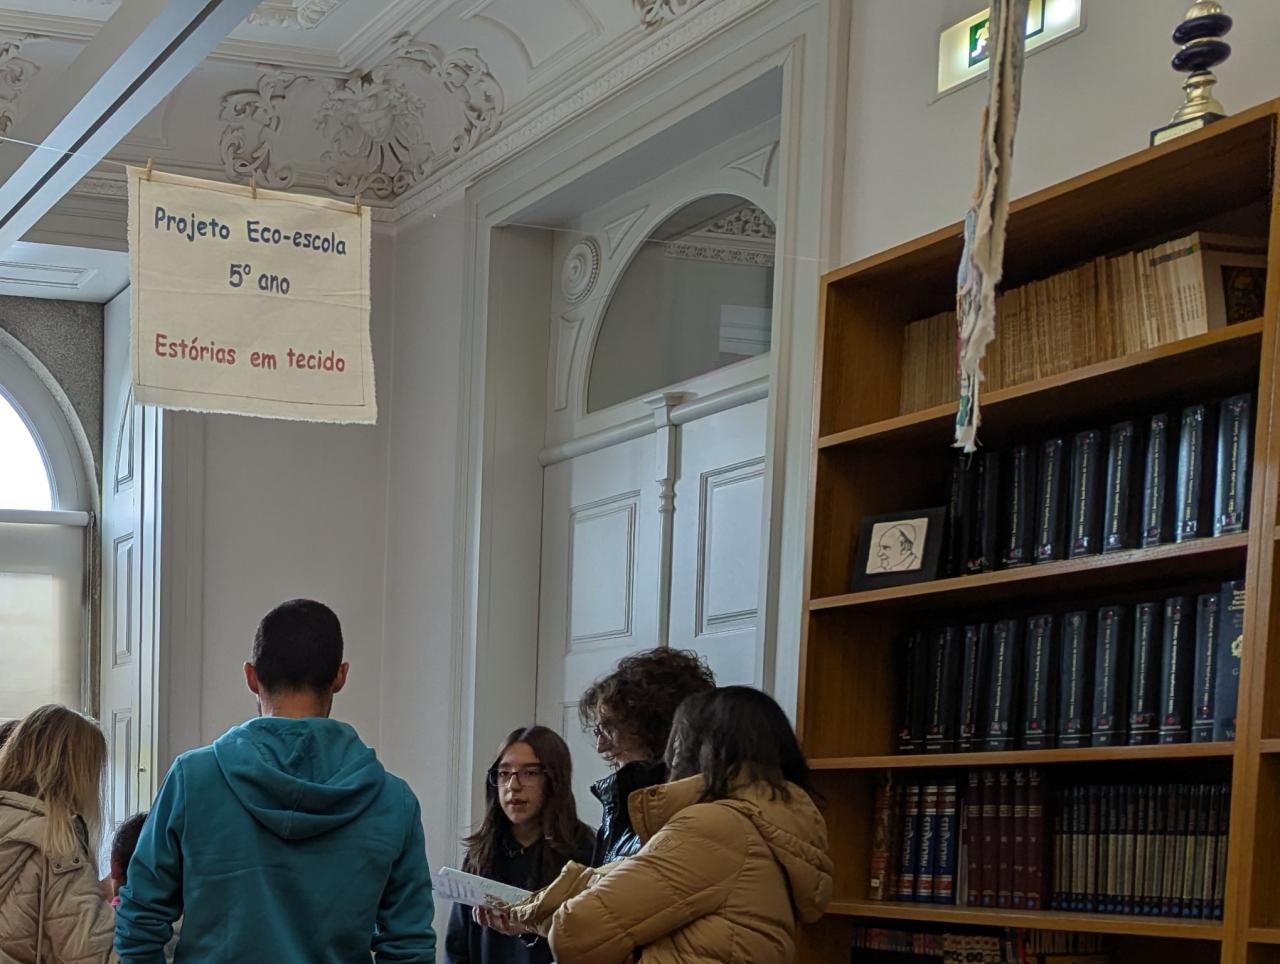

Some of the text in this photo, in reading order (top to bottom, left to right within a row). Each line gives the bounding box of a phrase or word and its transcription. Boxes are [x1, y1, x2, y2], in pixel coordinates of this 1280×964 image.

[154, 206, 346, 255] Projeto Eco-escola
[229, 263, 290, 294] 5º ano
[154, 333, 345, 373] Estórias em tecido
